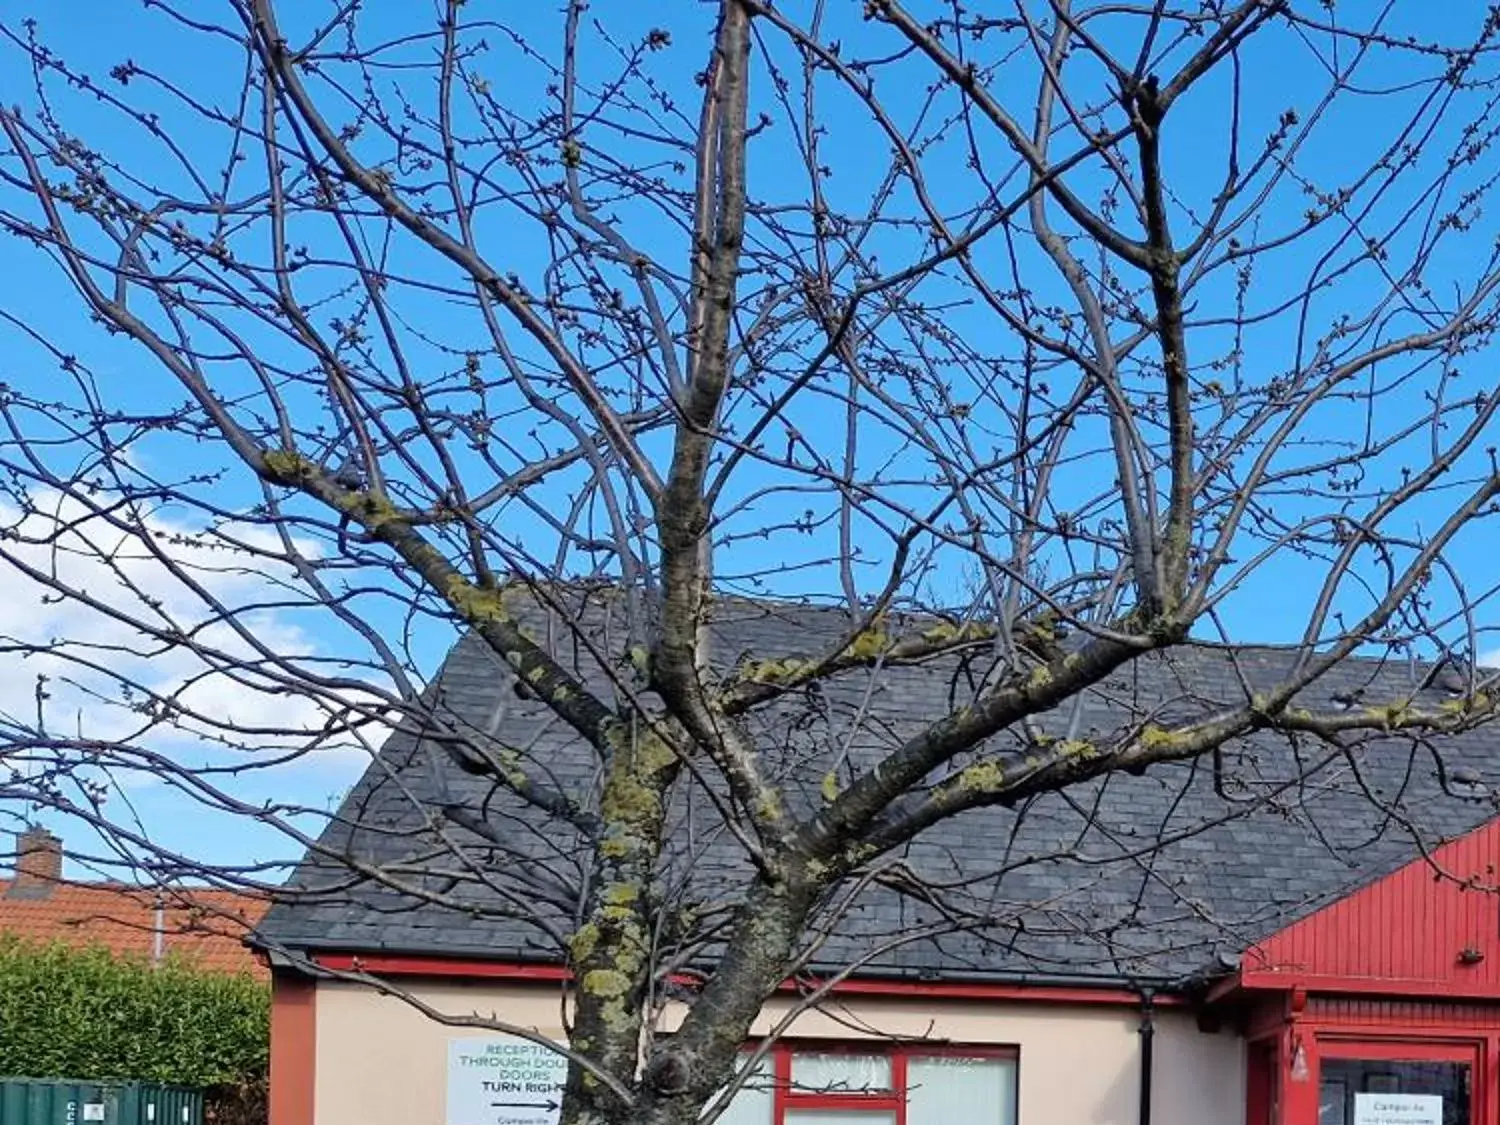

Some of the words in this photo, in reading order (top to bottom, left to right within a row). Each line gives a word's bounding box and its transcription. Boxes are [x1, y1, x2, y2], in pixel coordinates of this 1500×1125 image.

[487, 1045, 557, 1056] RECEPTIO
[459, 1055, 530, 1068] THROUGH
[533, 1057, 565, 1068] DOU
[500, 1070, 551, 1081] DOORS
[481, 1081, 521, 1093] TURN
